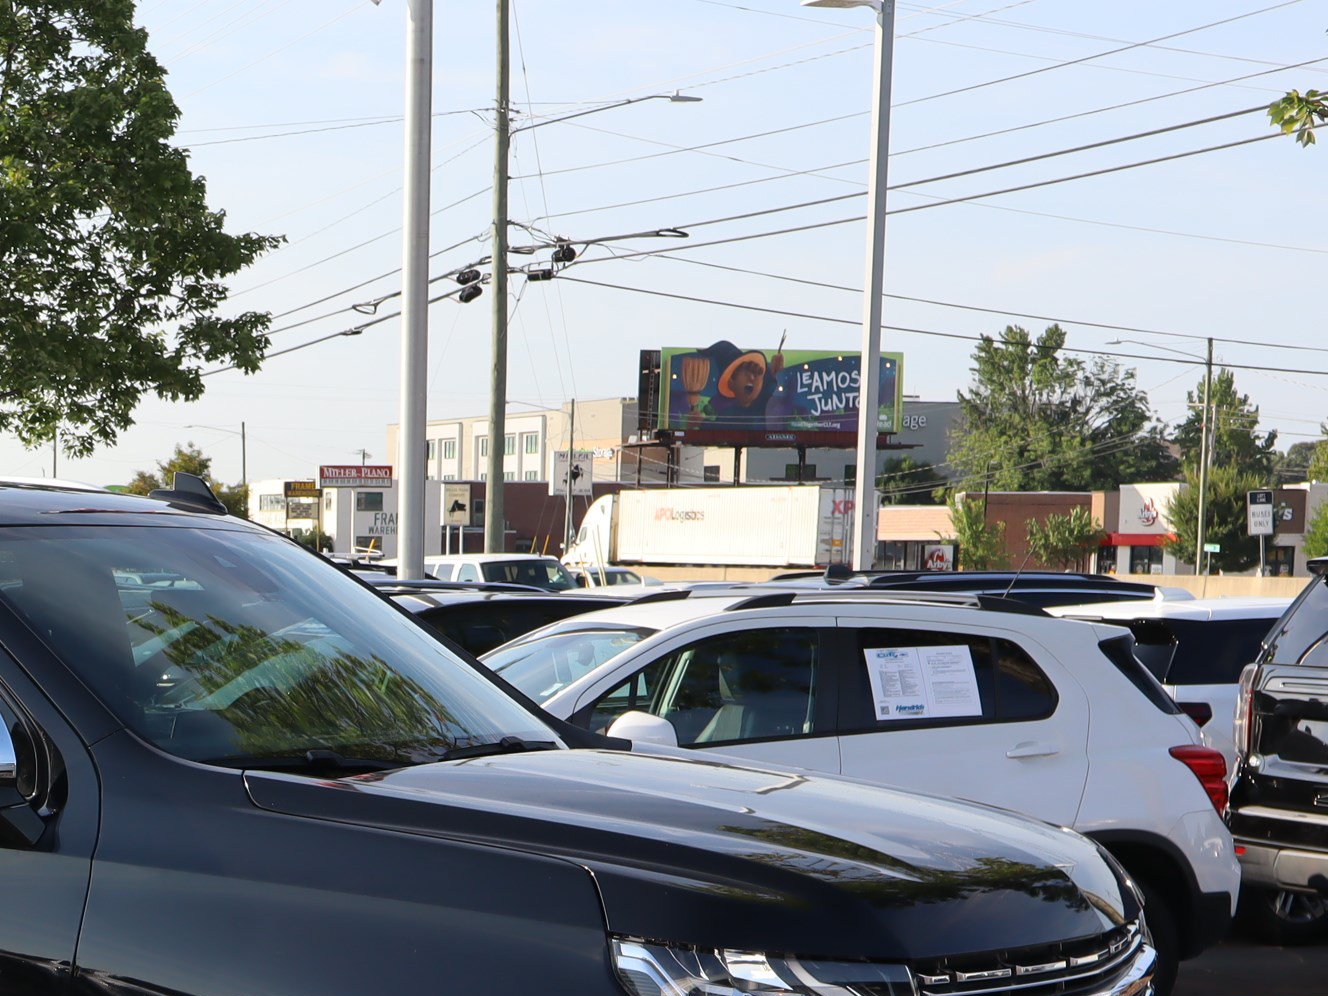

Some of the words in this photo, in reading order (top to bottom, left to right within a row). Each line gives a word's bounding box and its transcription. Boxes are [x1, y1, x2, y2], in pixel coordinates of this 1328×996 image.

[796, 370, 861, 394] LEAMOS
[361, 467, 390, 478] PIANO
[368, 525, 398, 535] WAREH
